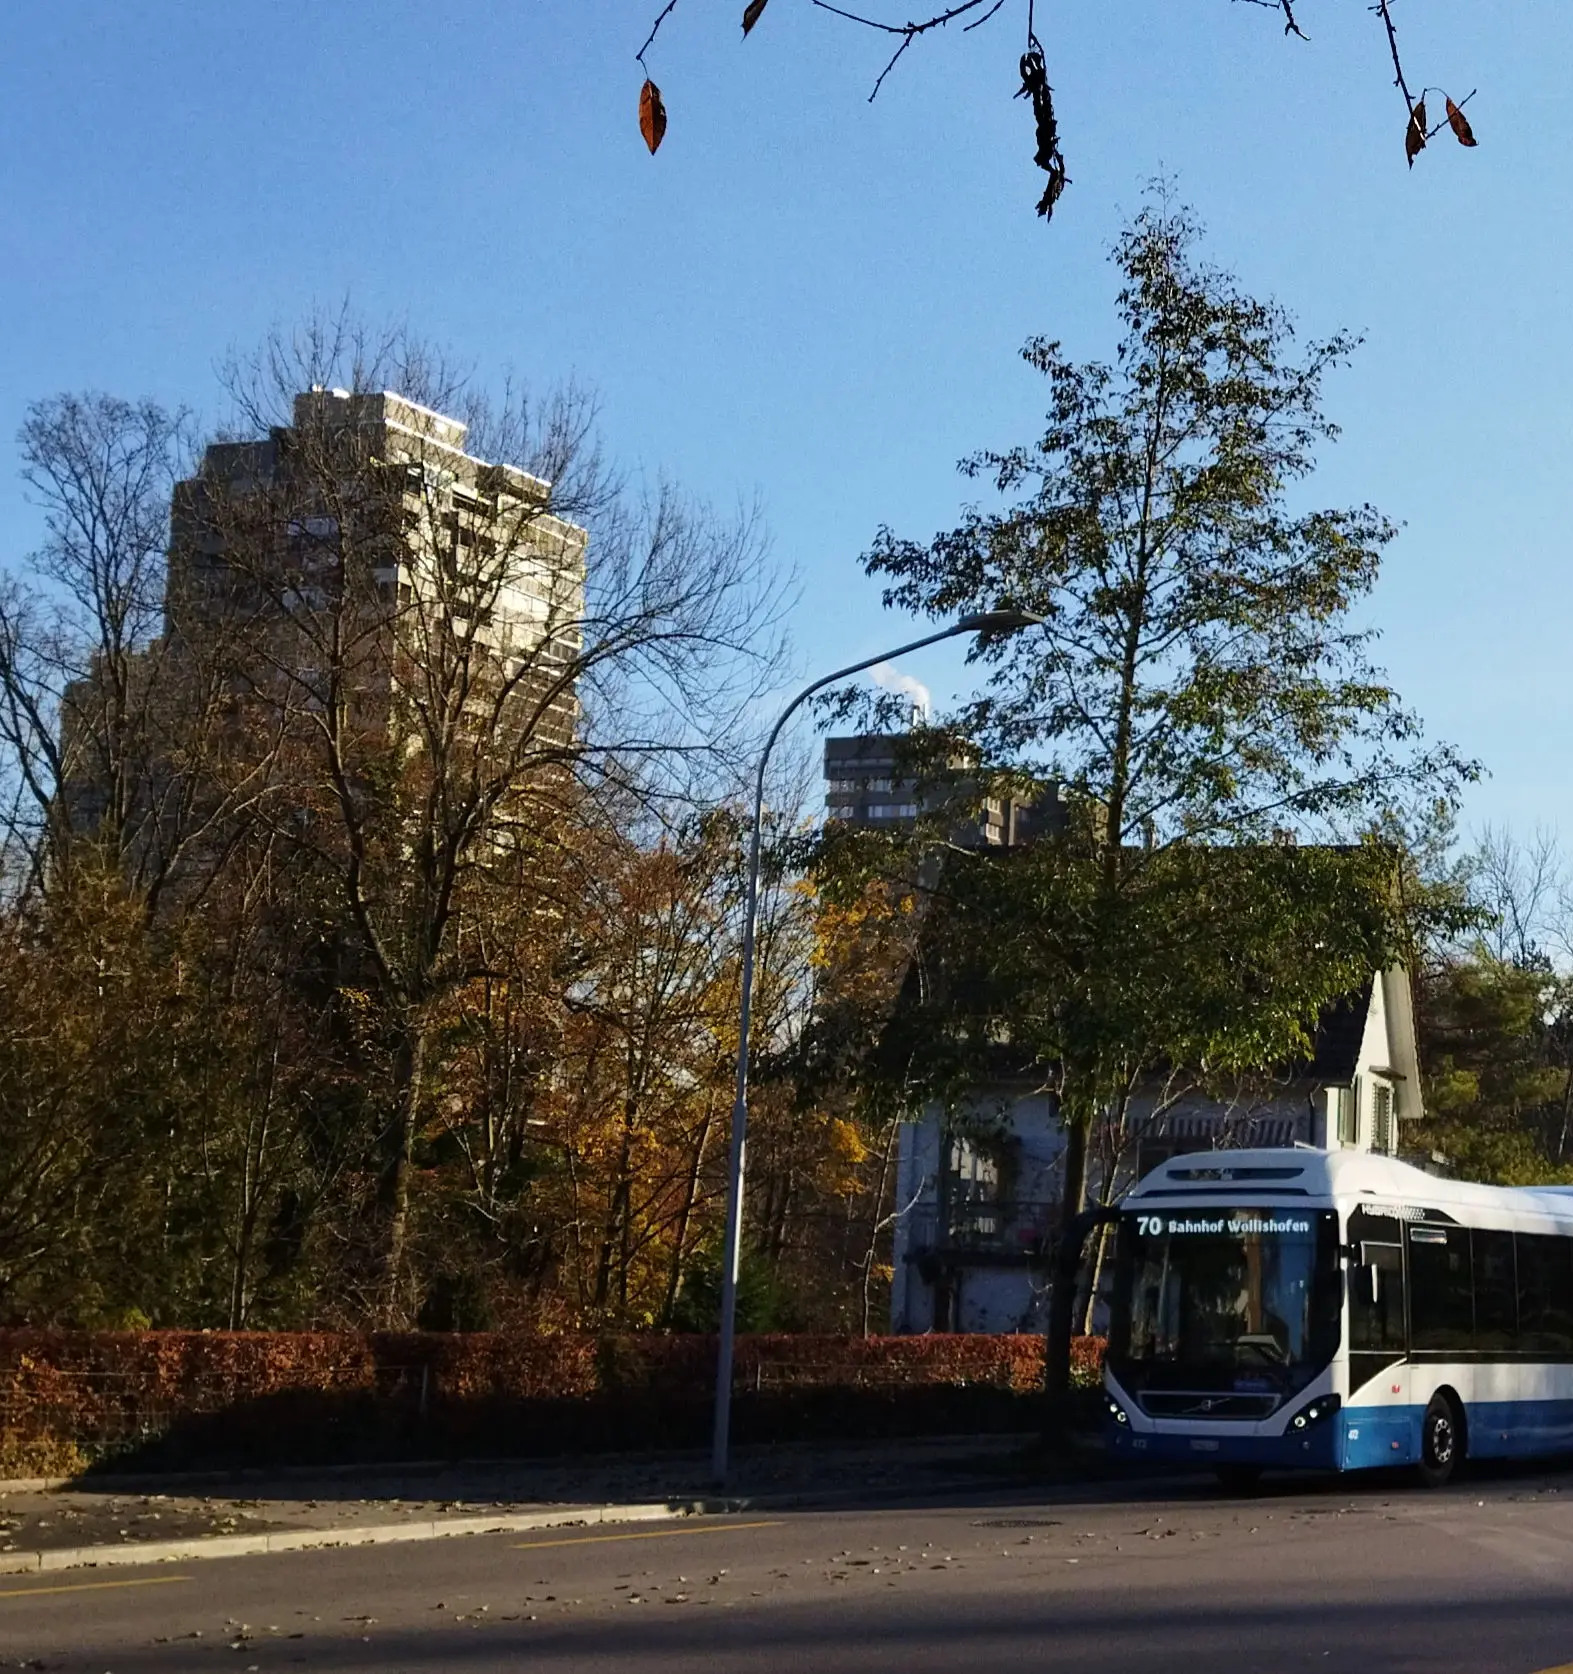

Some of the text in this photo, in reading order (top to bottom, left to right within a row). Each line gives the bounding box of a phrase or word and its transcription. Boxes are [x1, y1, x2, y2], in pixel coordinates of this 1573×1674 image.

[1136, 1216, 1309, 1236] 70 Bahnhof Wollishofen
